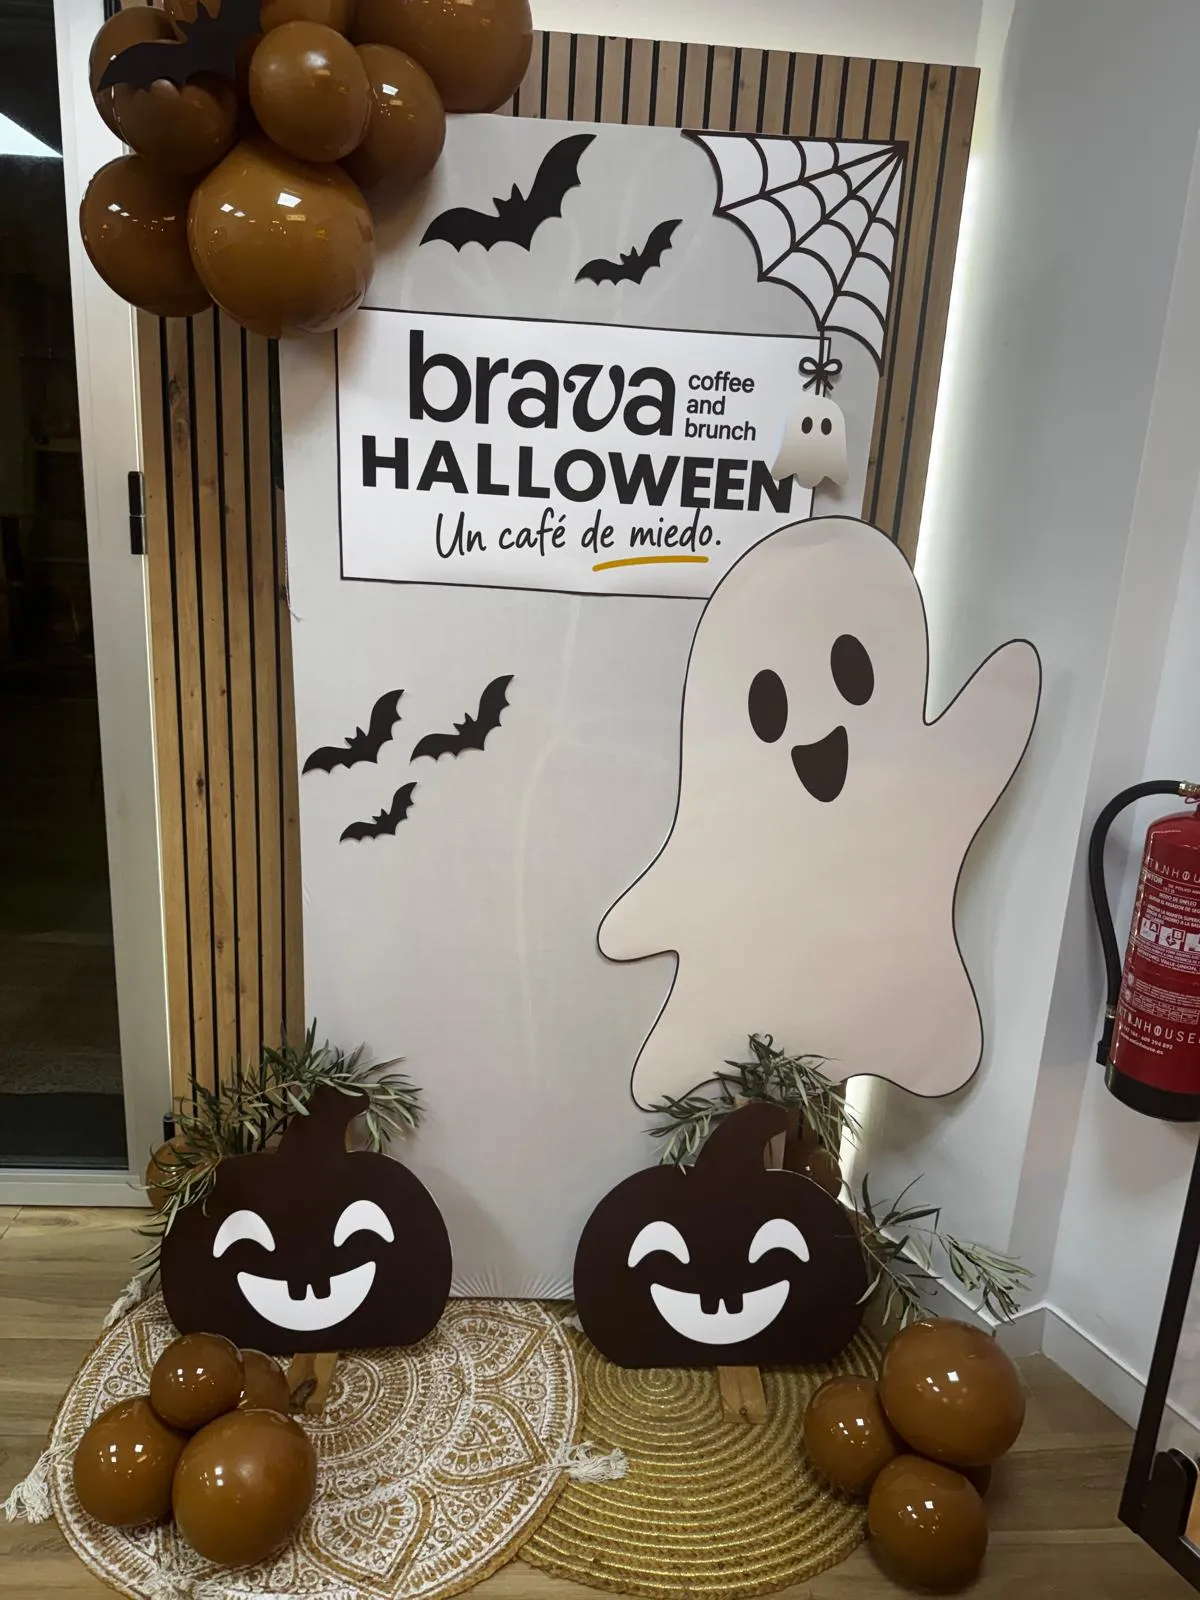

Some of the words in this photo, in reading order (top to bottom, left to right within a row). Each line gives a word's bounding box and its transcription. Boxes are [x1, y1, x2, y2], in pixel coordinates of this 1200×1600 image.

[409, 329, 676, 435] brava
[688, 370, 755, 394] coffee
[686, 395, 726, 416] and
[684, 417, 757, 441] brunch
[361, 435, 793, 514] HALLOWEEN
[435, 511, 487, 559] Un
[498, 506, 567, 557] café
[580, 508, 615, 554] de
[629, 508, 721, 553] miedo.
